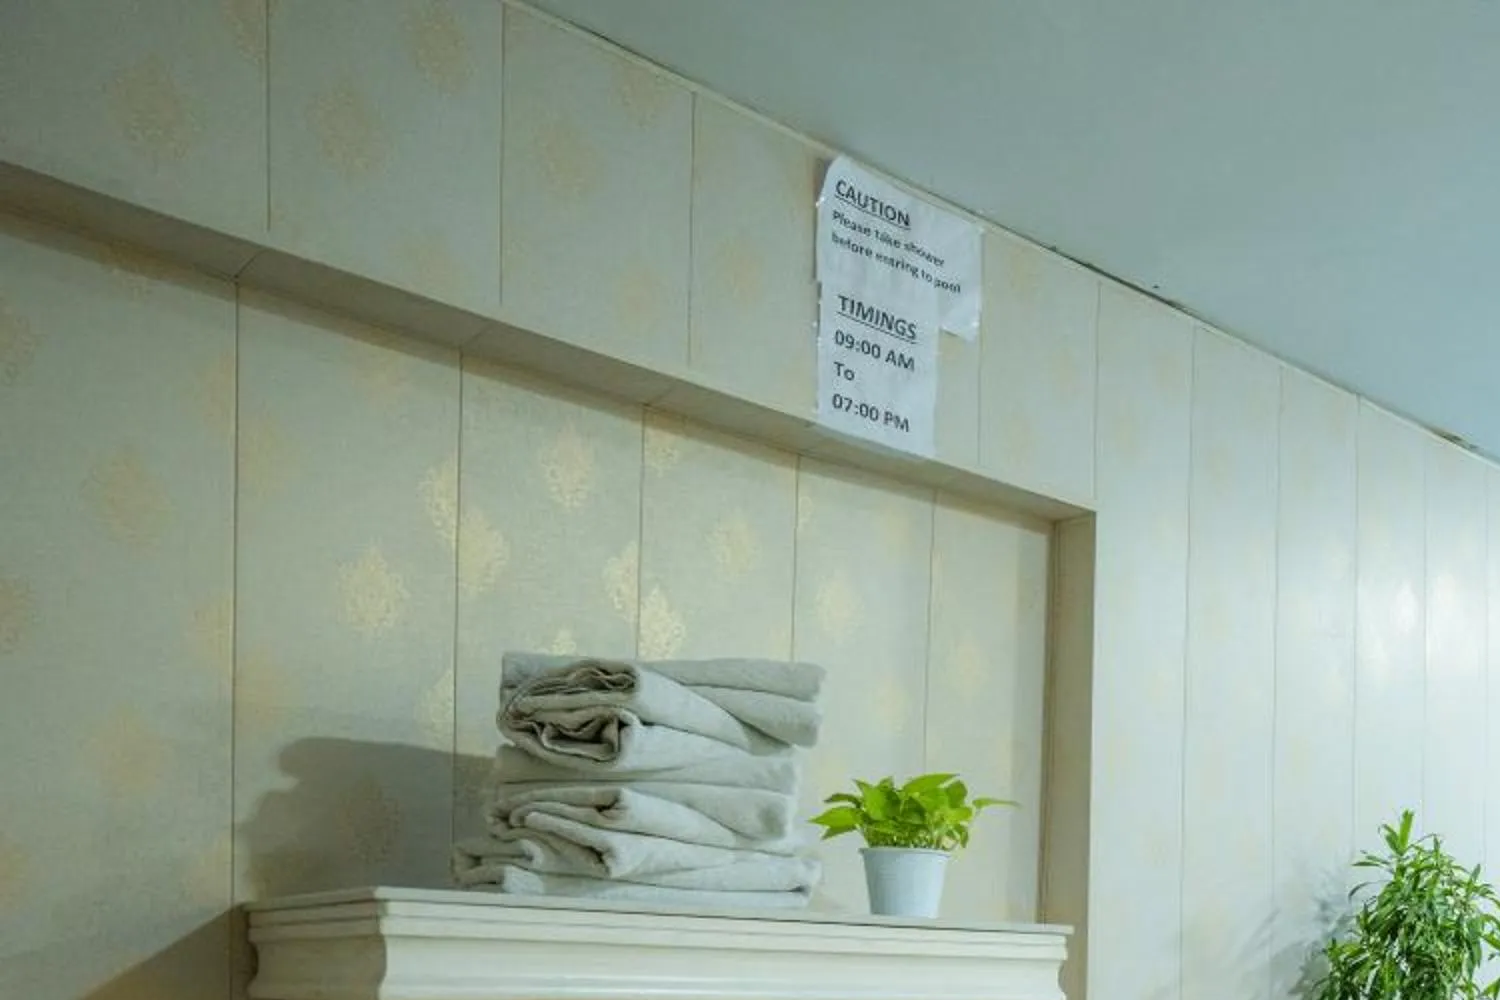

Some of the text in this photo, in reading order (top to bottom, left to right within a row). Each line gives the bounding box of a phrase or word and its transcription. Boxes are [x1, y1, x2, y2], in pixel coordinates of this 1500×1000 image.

[832, 210, 872, 237] Please
[835, 179, 910, 228] CAUTION
[831, 231, 873, 258] before
[921, 268, 933, 283] to
[837, 295, 917, 341] TIMINGS
[833, 361, 855, 381] To
[834, 329, 915, 371] 09:00 AM
[832, 393, 910, 432] 07:00 PM
